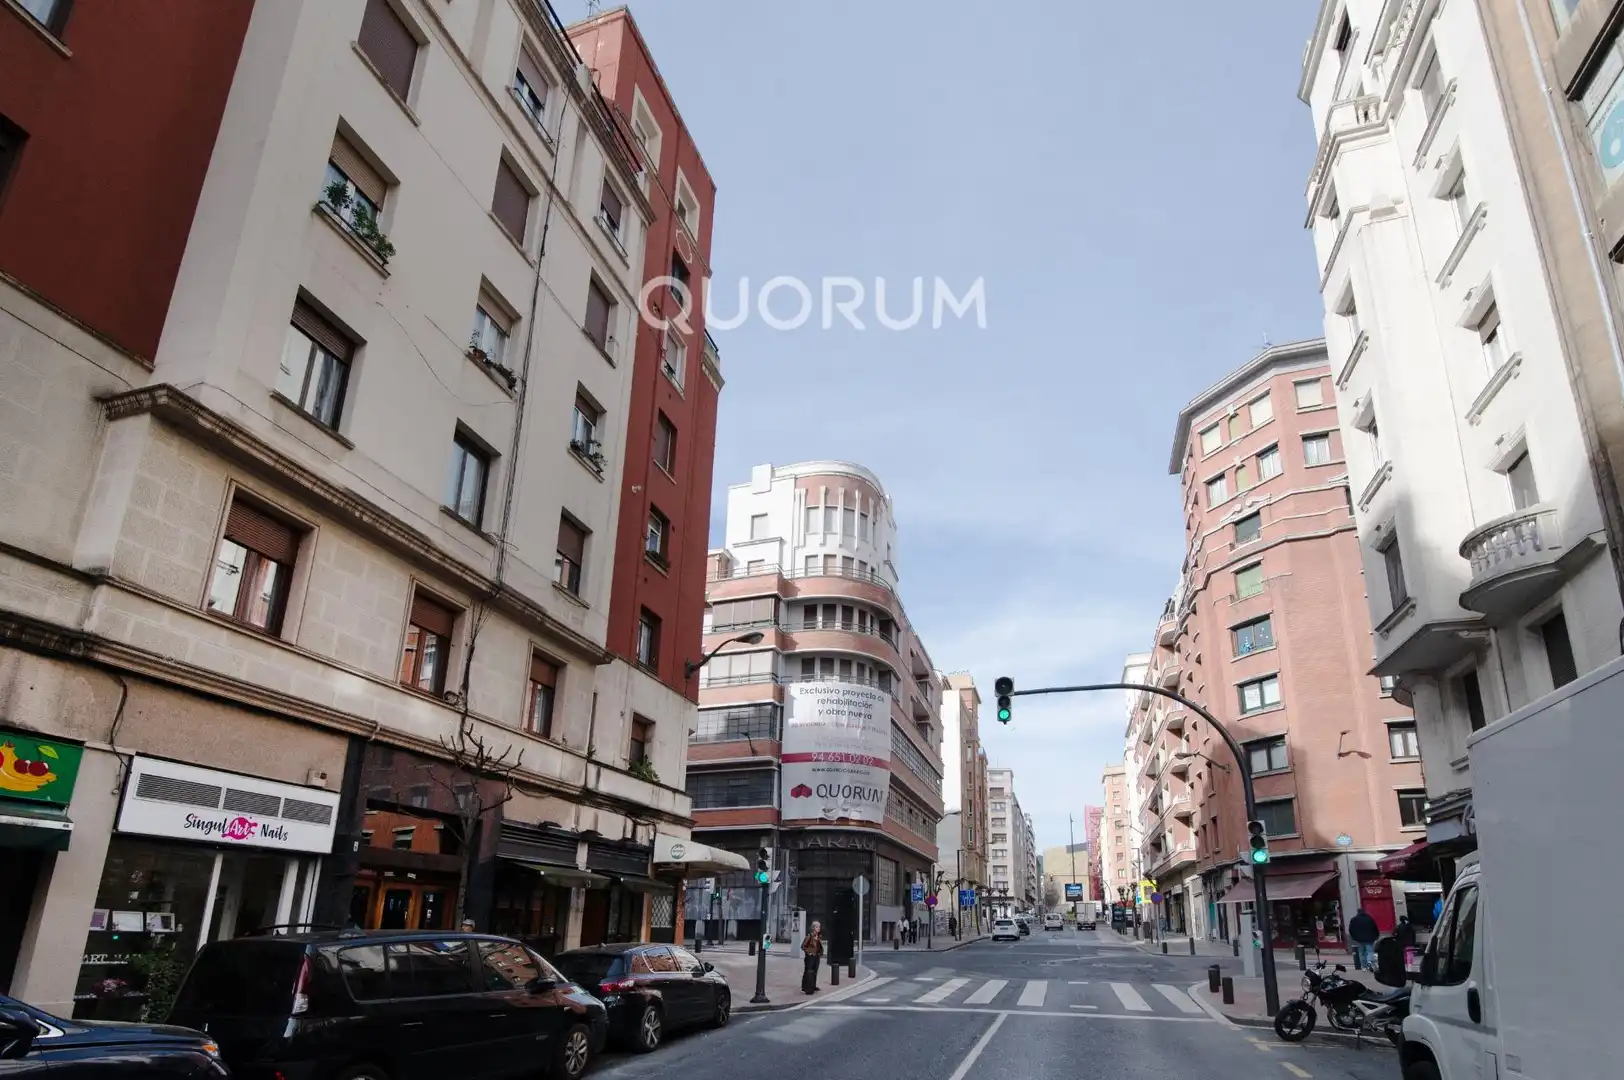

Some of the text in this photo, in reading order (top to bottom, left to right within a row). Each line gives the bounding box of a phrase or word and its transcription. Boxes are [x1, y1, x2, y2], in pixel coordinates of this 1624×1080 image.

[799, 687, 840, 695] Exclusivo
[842, 689, 876, 700] proyecto
[826, 707, 846, 716] obra
[848, 711, 873, 720] nueva
[812, 752, 874, 766] 94 651 02 02
[816, 783, 884, 803] QUORUM
[260, 823, 289, 842] Nails
